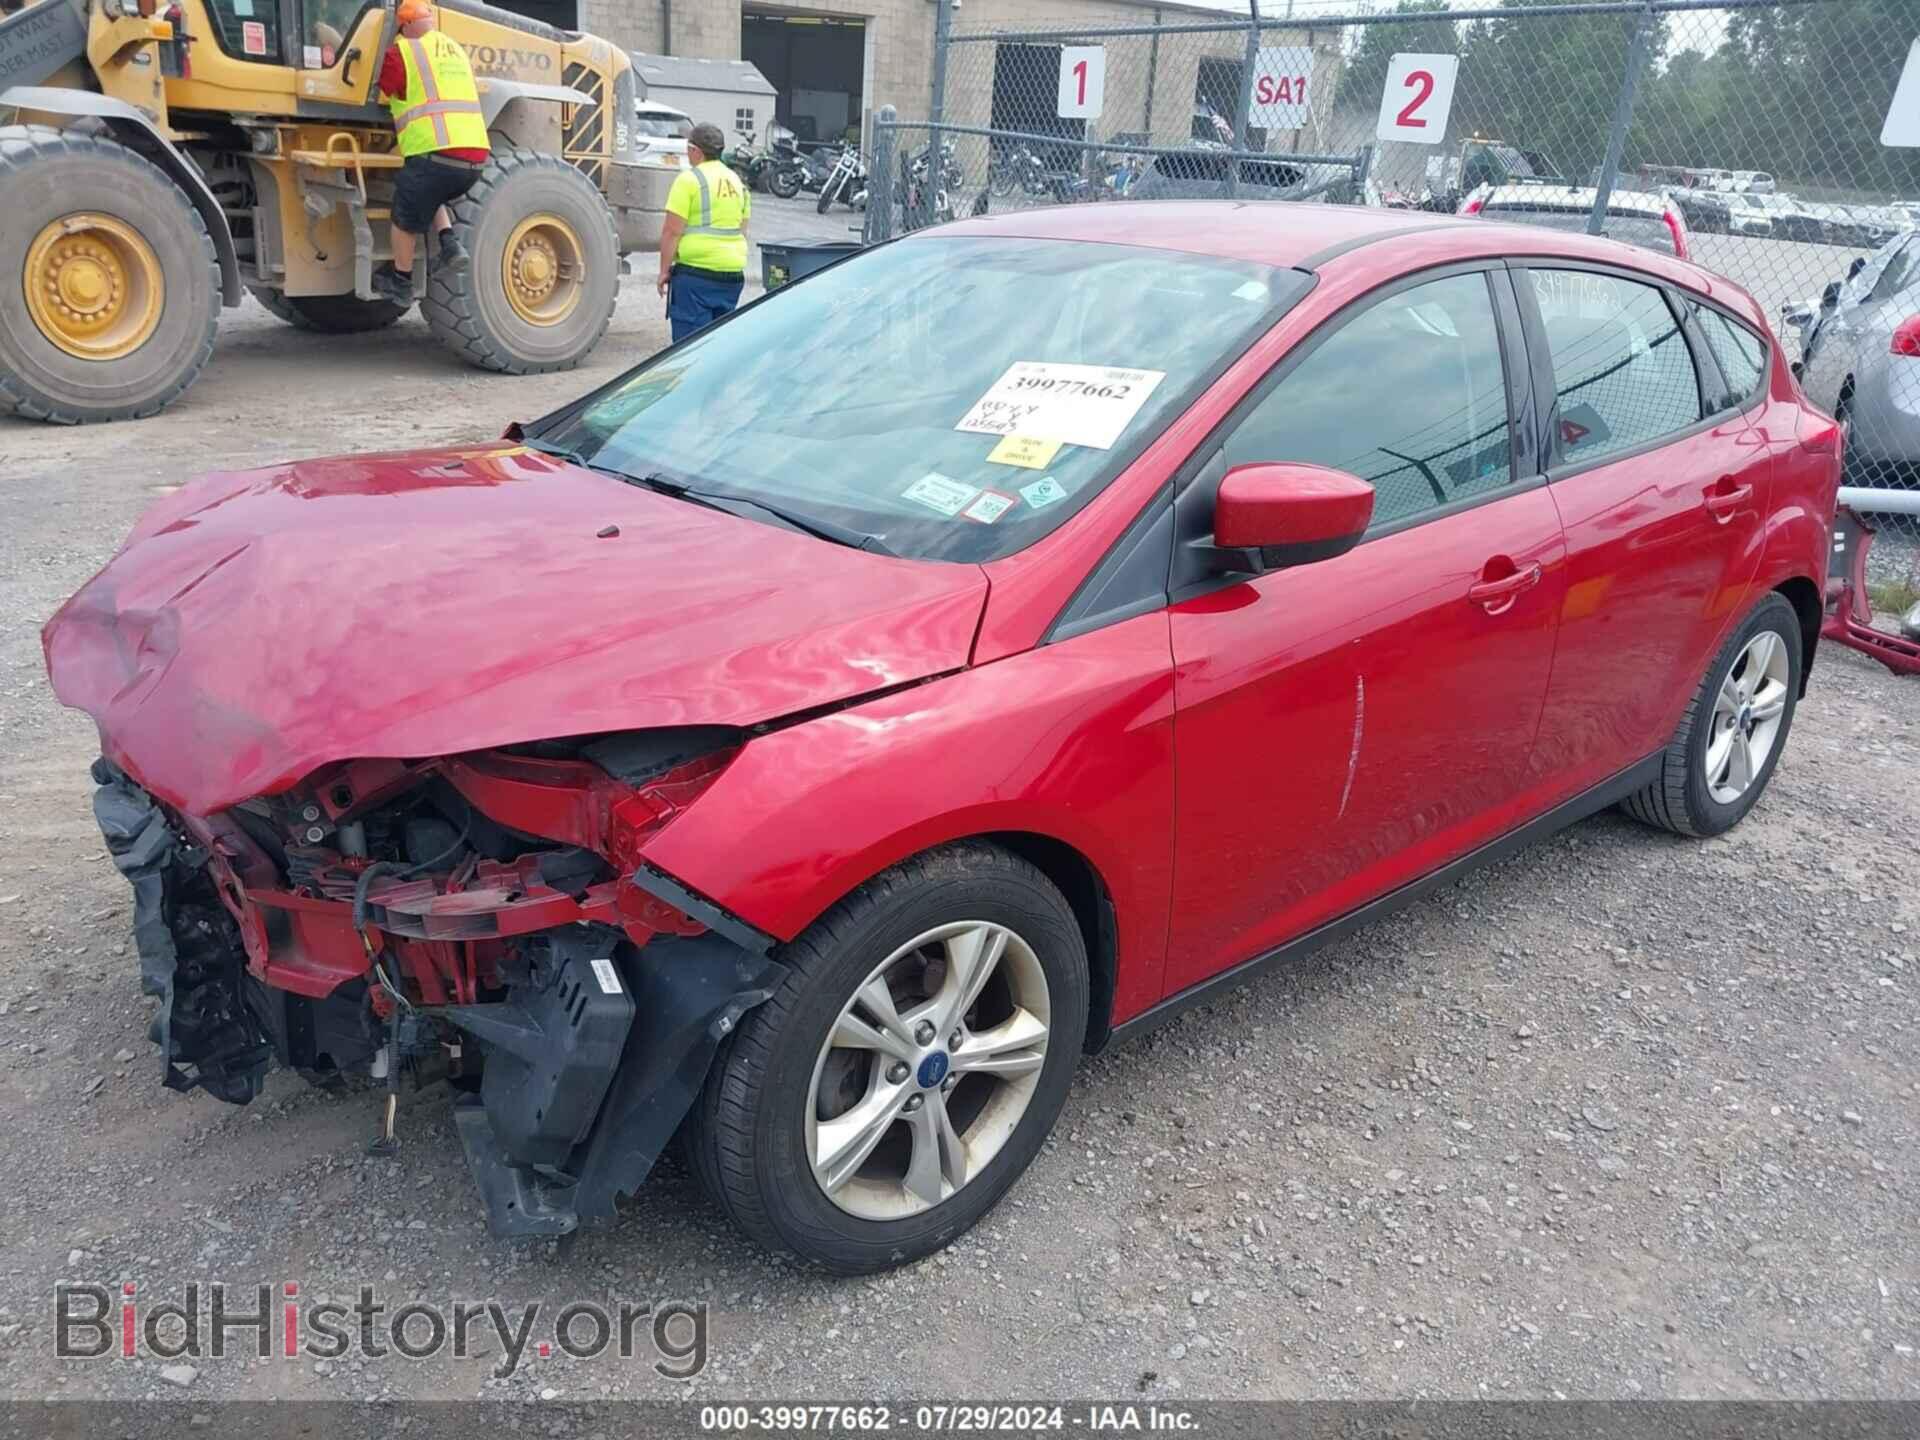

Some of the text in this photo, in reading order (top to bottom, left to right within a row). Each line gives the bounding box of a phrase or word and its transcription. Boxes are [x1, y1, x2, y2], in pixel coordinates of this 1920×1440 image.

[460, 44, 552, 70] VOLVO
[1072, 60, 1088, 105] 1
[1256, 75, 1307, 105] SA1
[1395, 70, 1435, 128] 2
[1008, 377, 1131, 399] 39977662
